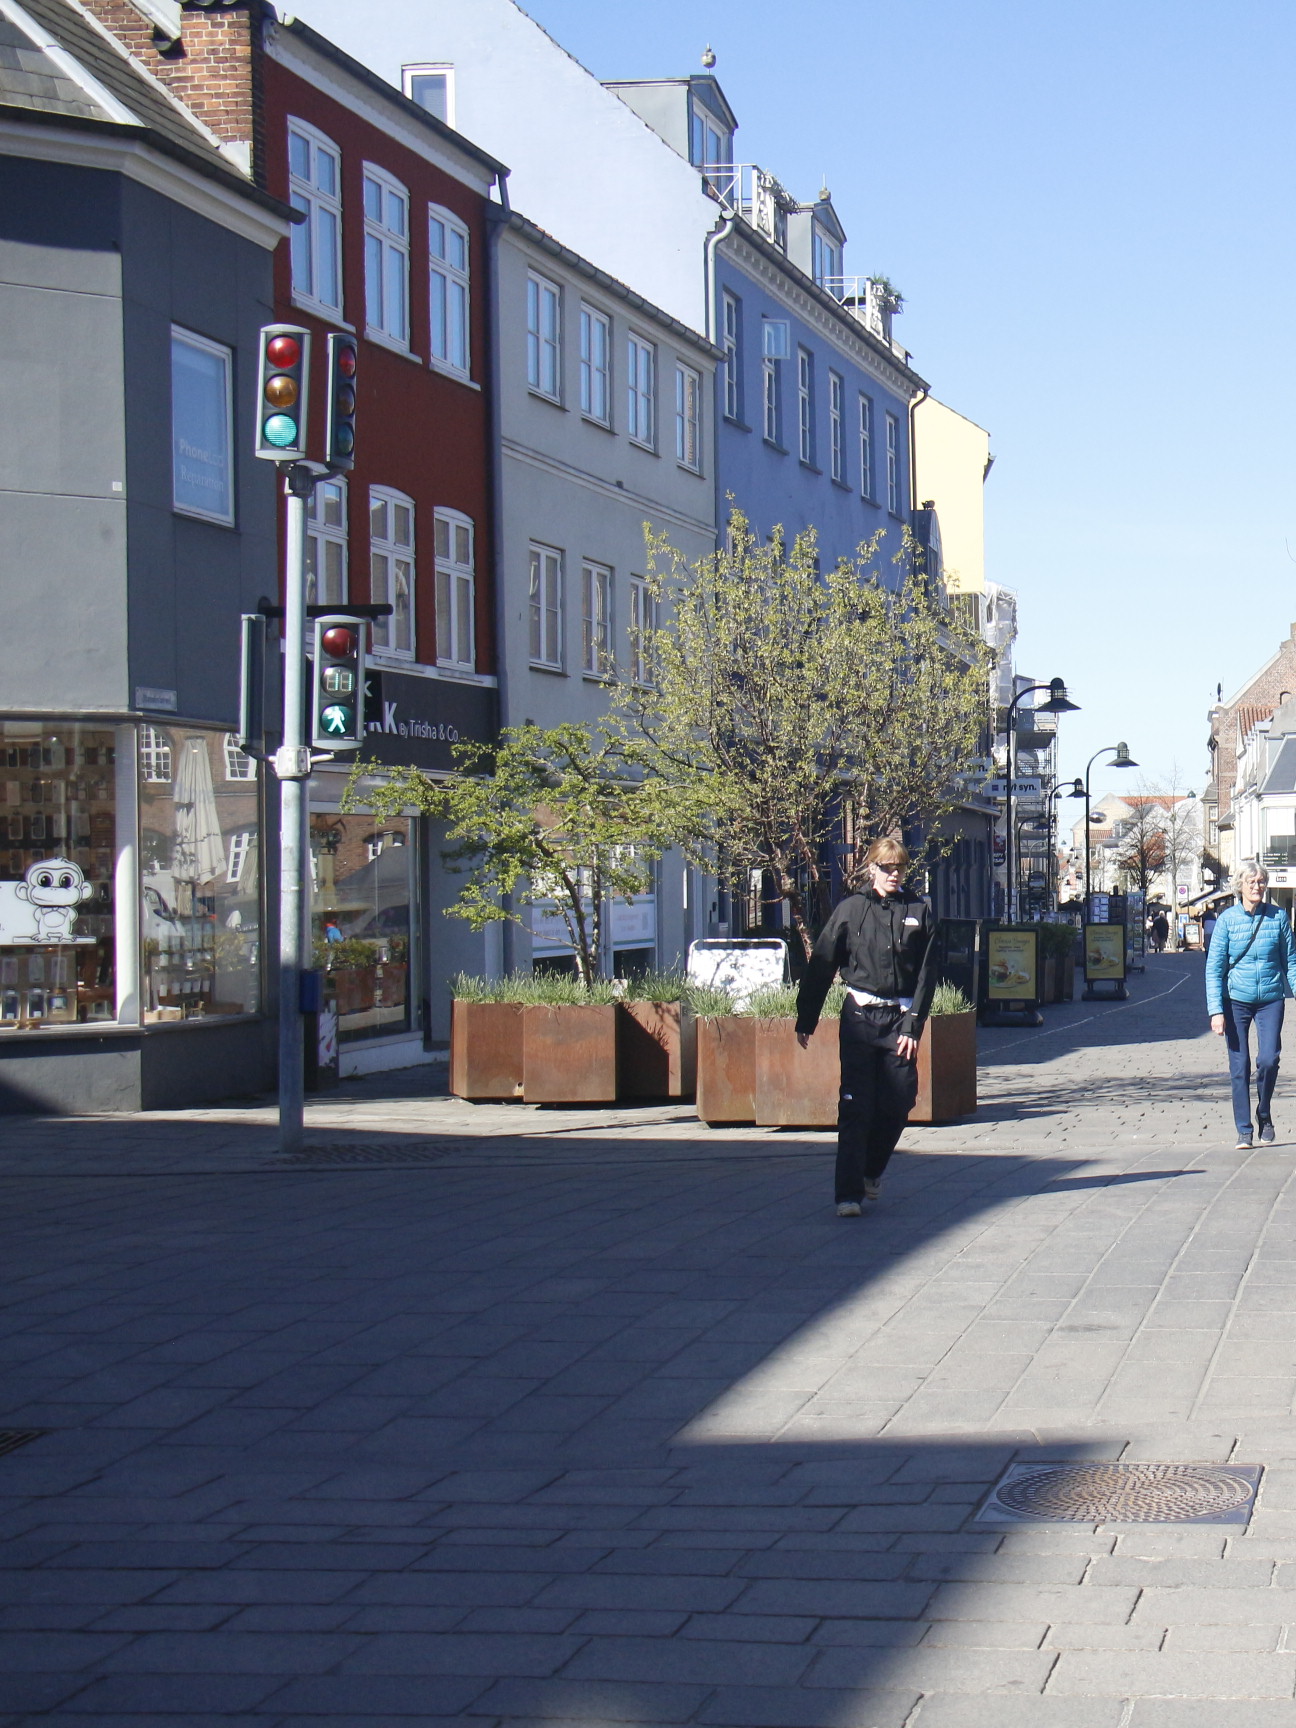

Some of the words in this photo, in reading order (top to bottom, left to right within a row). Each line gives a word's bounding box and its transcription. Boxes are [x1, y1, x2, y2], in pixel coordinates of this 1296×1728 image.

[399, 723, 408, 739] By
[410, 720, 437, 739] Trisha
[439, 724, 445, 741] &
[447, 725, 460, 742] Co.
[1018, 783, 1037, 792] syn.
